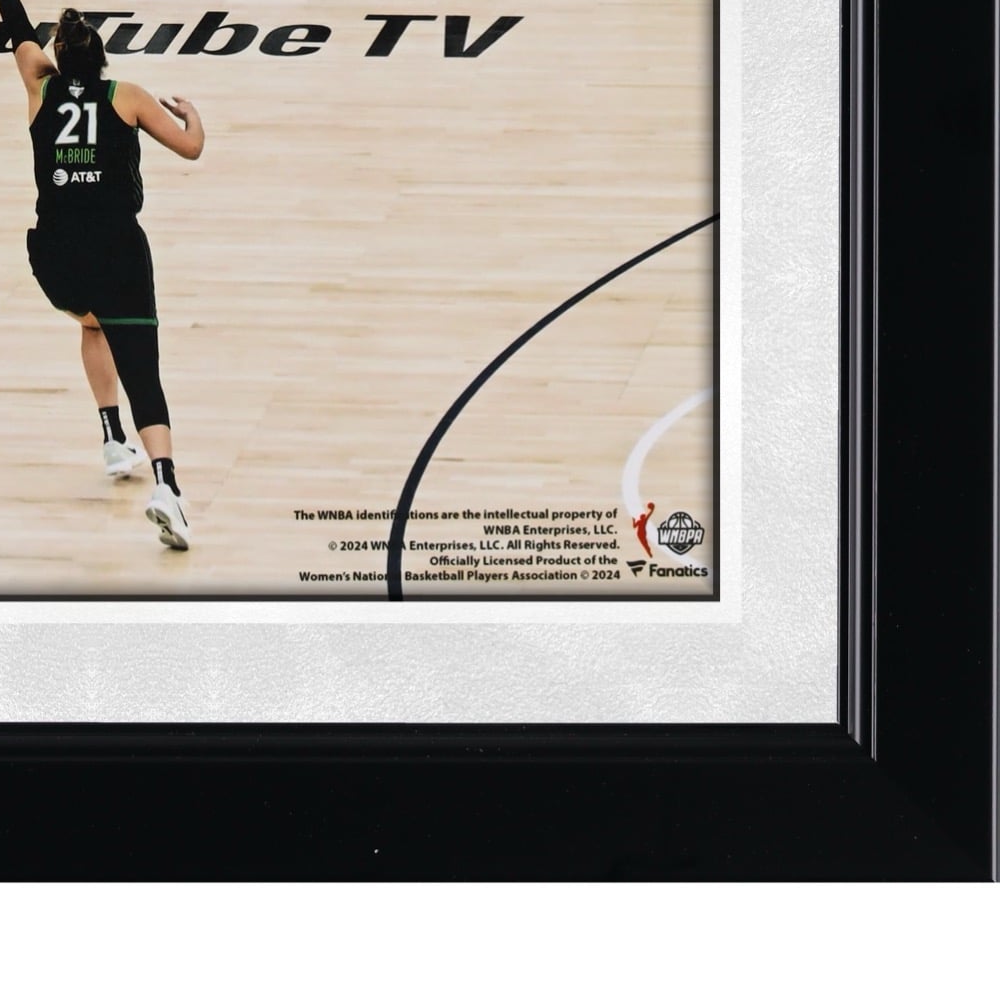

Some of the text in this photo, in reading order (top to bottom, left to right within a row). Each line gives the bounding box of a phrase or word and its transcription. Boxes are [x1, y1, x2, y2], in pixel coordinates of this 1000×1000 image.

[364, 14, 525, 58] TV
[55, 102, 97, 145] 21
[56, 148, 96, 164] McBRIDE
[71, 171, 102, 183] AT&T
